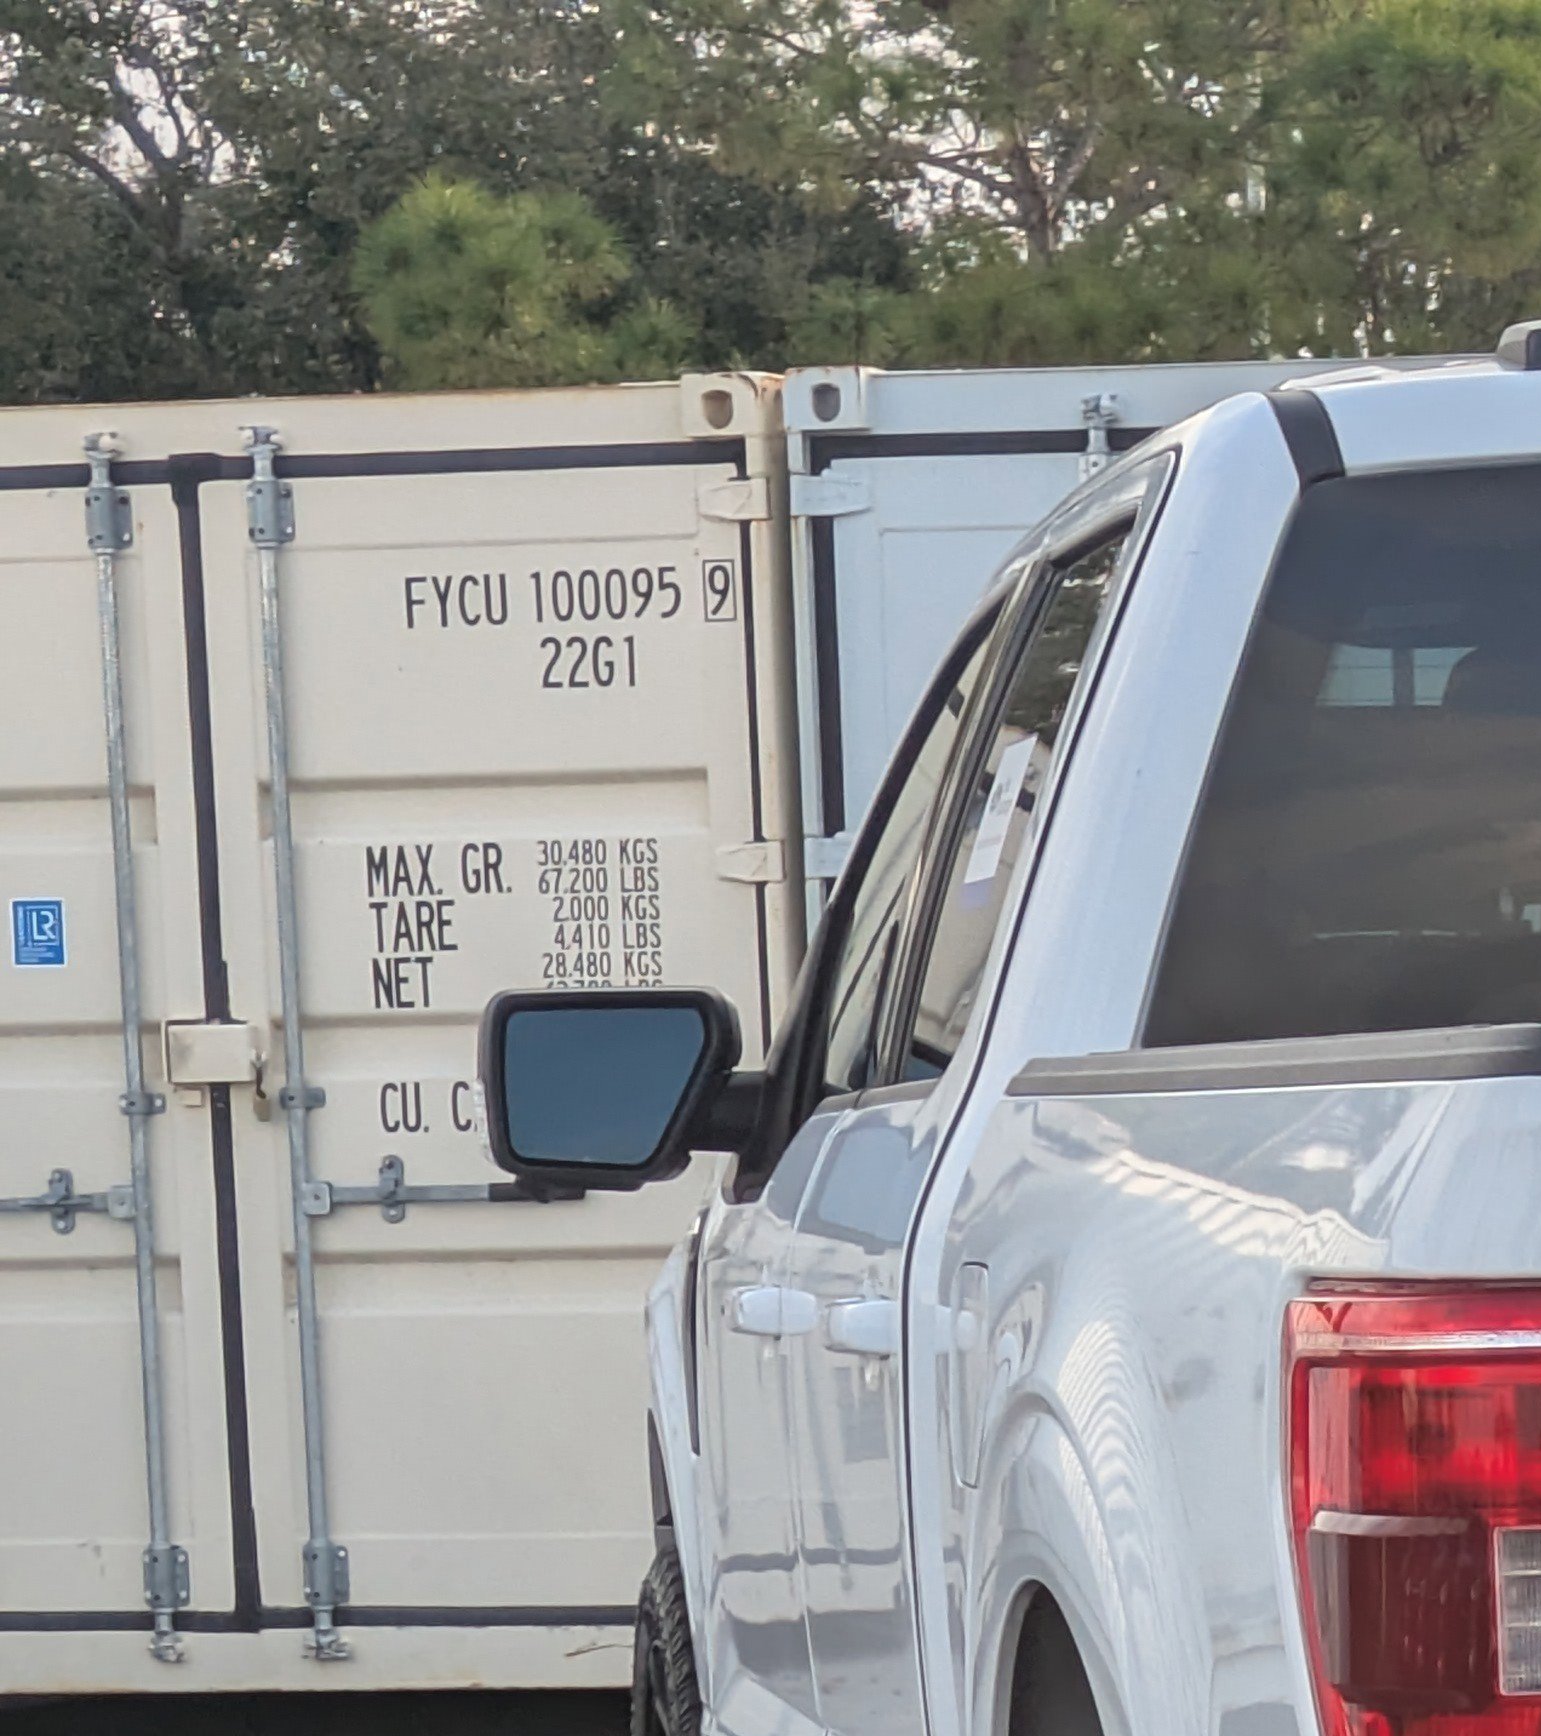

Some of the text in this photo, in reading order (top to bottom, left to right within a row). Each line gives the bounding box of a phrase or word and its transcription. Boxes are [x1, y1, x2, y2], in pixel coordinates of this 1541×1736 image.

[404, 564, 731, 629] FYCU 100095 9
[540, 635, 637, 688] 22G1
[366, 838, 659, 897] MAX. GR. 30.480 KGS
[538, 866, 660, 895] 67.200 LBS
[369, 894, 661, 953] TARE 2.000 KGS
[622, 922, 662, 949] LBS
[372, 951, 663, 1009] NET 28.480 KGS
[380, 1081, 430, 1133] CU.
